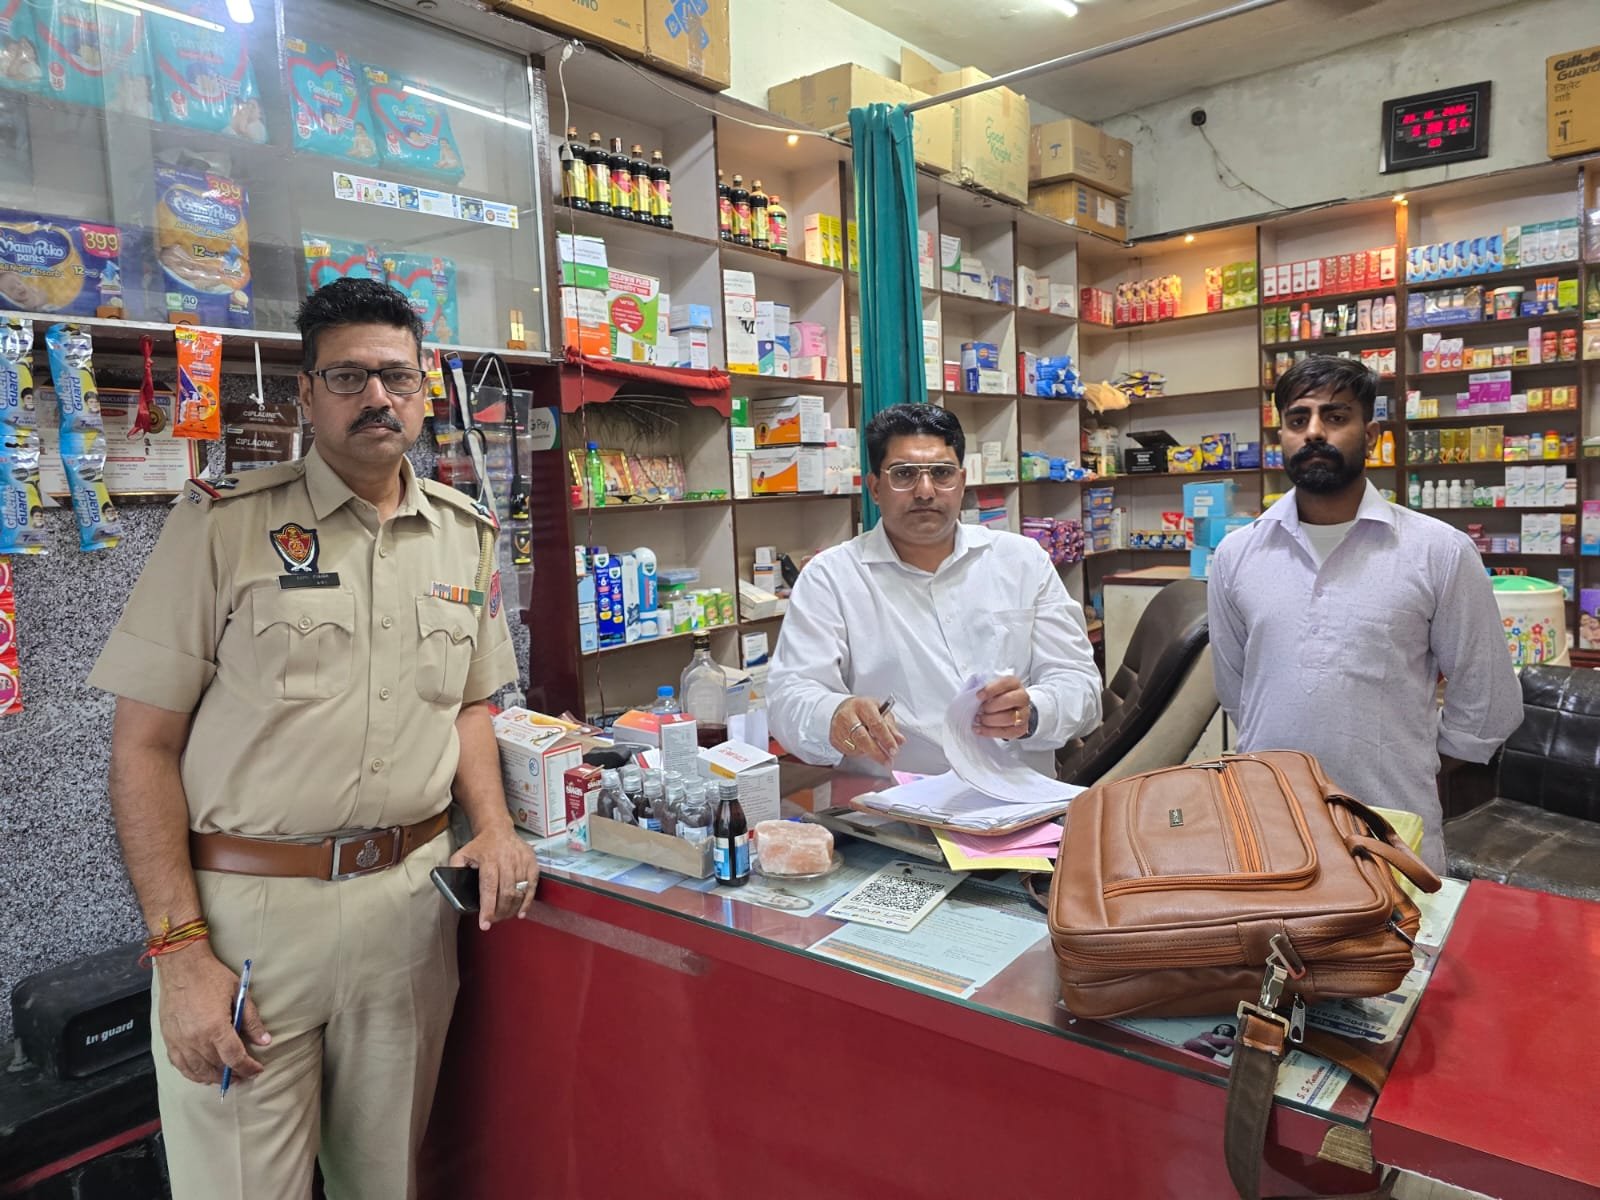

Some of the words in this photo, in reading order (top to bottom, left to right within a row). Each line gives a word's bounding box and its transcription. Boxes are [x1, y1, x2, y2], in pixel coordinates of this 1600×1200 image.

[84, 230, 119, 252] 399
[235, 438, 275, 448] CIPLADINE
[100, 1018, 135, 1043] guard
